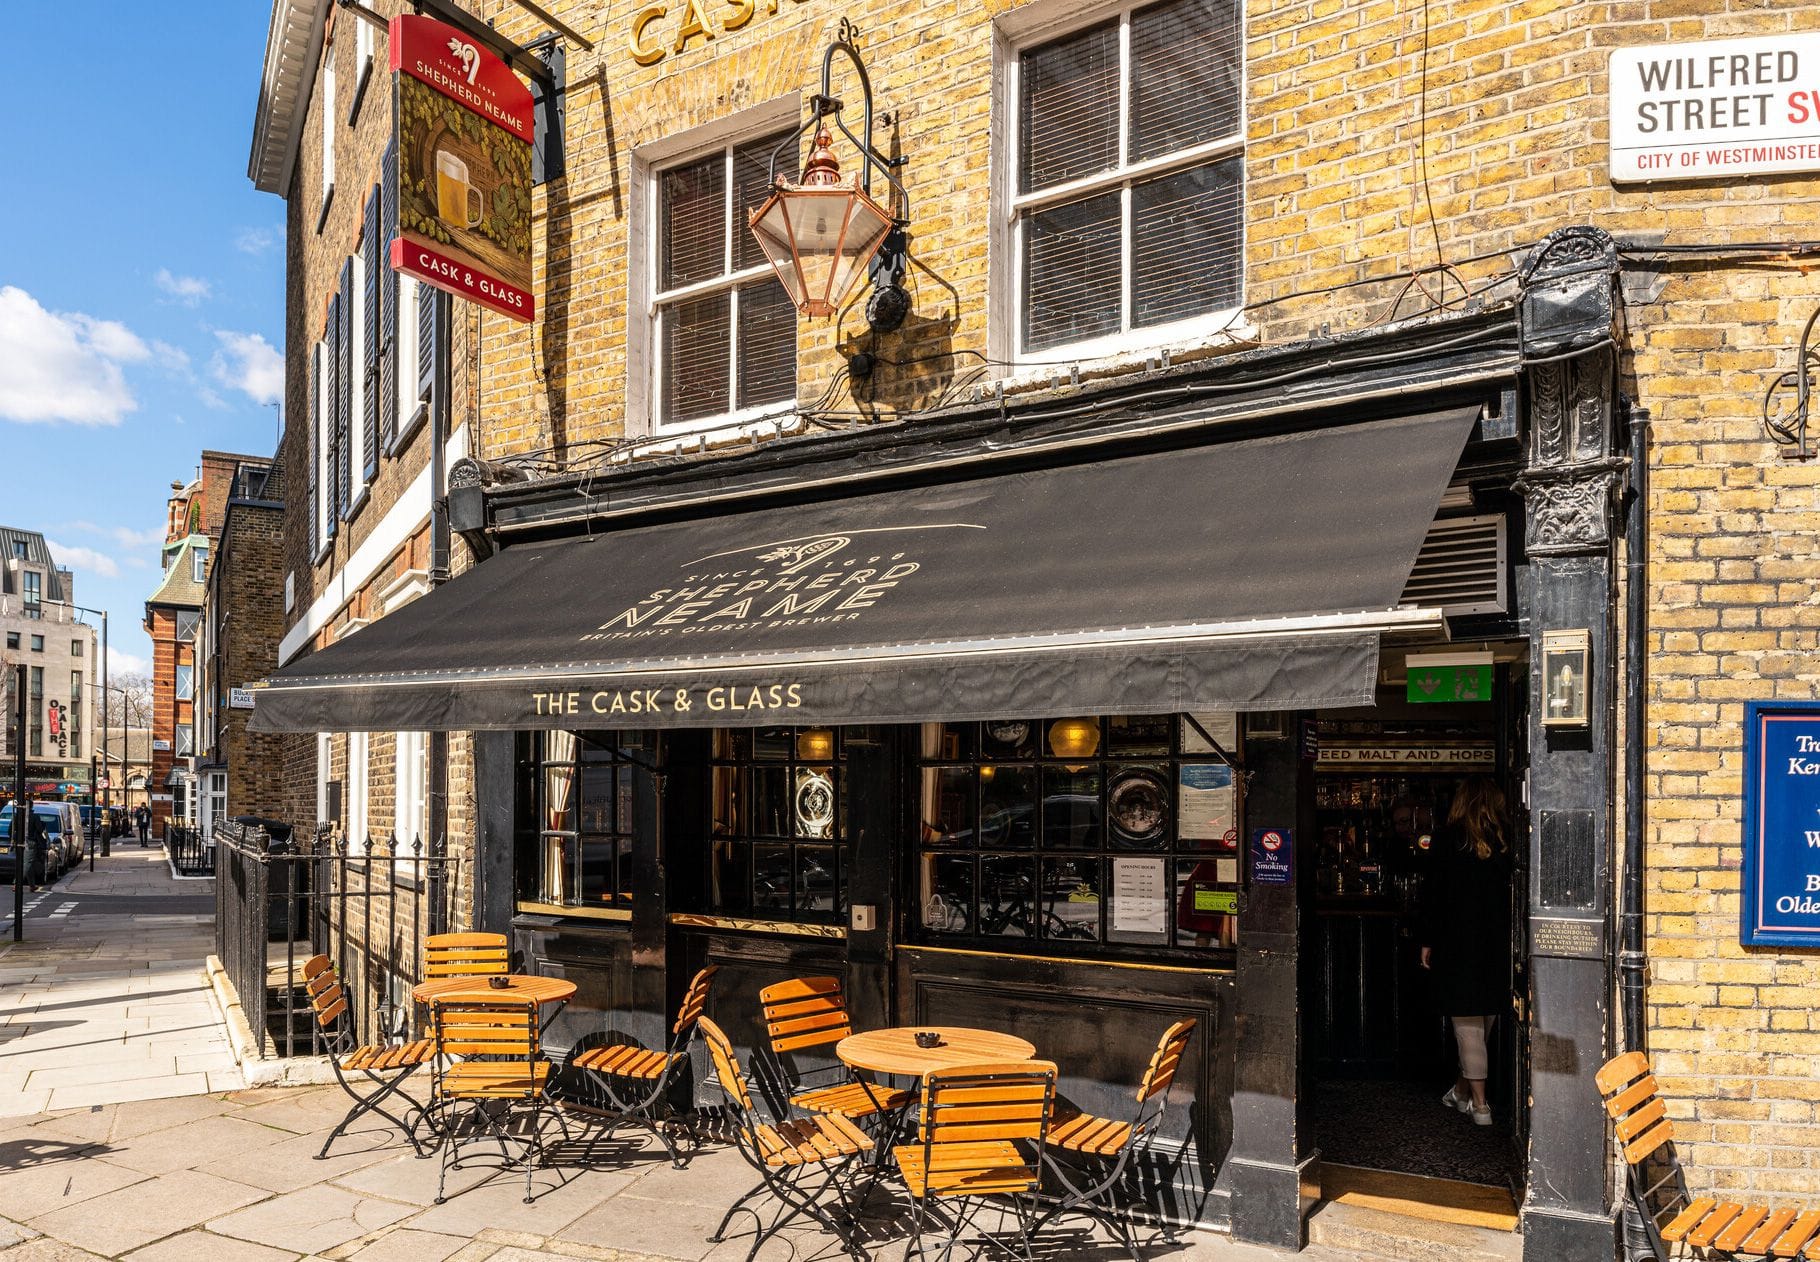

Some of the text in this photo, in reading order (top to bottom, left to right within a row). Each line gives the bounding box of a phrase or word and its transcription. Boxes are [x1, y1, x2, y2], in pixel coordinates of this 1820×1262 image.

[629, 0, 811, 64] CAS
[1637, 50, 1798, 92] WILFRED
[416, 60, 523, 131] SHEPHERD NEAME
[1637, 93, 1774, 133] STREET
[1638, 144, 1820, 169] CITY OF WESTMINSTE
[419, 254, 523, 308] CASK & GLASS
[638, 562, 920, 605] SHEPHERD
[684, 552, 905, 582] SINCE 1698
[599, 582, 899, 630] NEAME
[579, 612, 860, 641] BRITAIN'S OLDEST BREWER
[533, 683, 802, 715] THE CASK & GLASS
[59, 705, 67, 758] PALACE
[1318, 750, 1493, 760] EED MALT AND HOPS
[1255, 862, 1289, 872] Smoking
[1265, 853, 1278, 861] No
[1776, 895, 1820, 914] Olde
